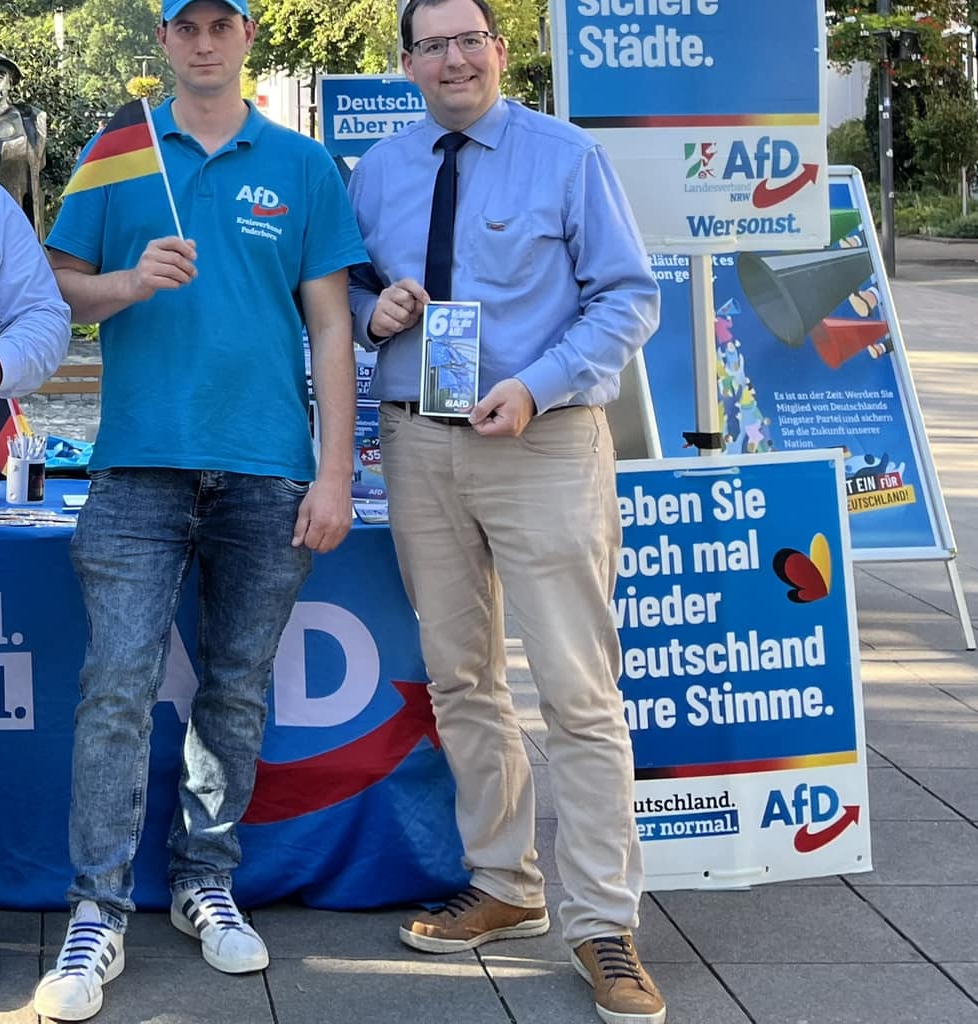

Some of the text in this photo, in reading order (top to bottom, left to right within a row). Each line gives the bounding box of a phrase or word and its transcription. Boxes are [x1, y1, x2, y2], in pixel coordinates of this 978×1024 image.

[579, 24, 714, 68] Städte.
[336, 92, 427, 112] Deutschl
[337, 117, 387, 134] Aber
[722, 136, 799, 180] AfD
[235, 185, 279, 207] AfD
[684, 183, 751, 192] Landesverband
[730, 193, 751, 202] NRW
[686, 213, 801, 237] Wer sonst.
[429, 308, 450, 336] 6
[774, 392, 784, 400] Es
[786, 391, 797, 400] ist
[798, 392, 809, 400] an
[810, 391, 824, 400] der
[844, 390, 879, 399] Werden
[880, 390, 894, 399] Sie
[776, 401, 888, 414] Mitglied von Deutschlands
[778, 413, 893, 426] jüngster Partei und sichern
[782, 427, 880, 436] Sie die Zukunft unserer
[857, 476, 875, 493] EIN
[879, 474, 898, 488] FÜR
[617, 478, 766, 527] eben Sie
[847, 491, 909, 512] EUTSCHLAND!
[616, 529, 759, 578] och mal
[619, 625, 826, 679] eutschland
[686, 681, 834, 727] Stimme.
[634, 791, 736, 813] utschland.
[760, 783, 839, 828] AfD
[637, 813, 738, 837] er normal.
